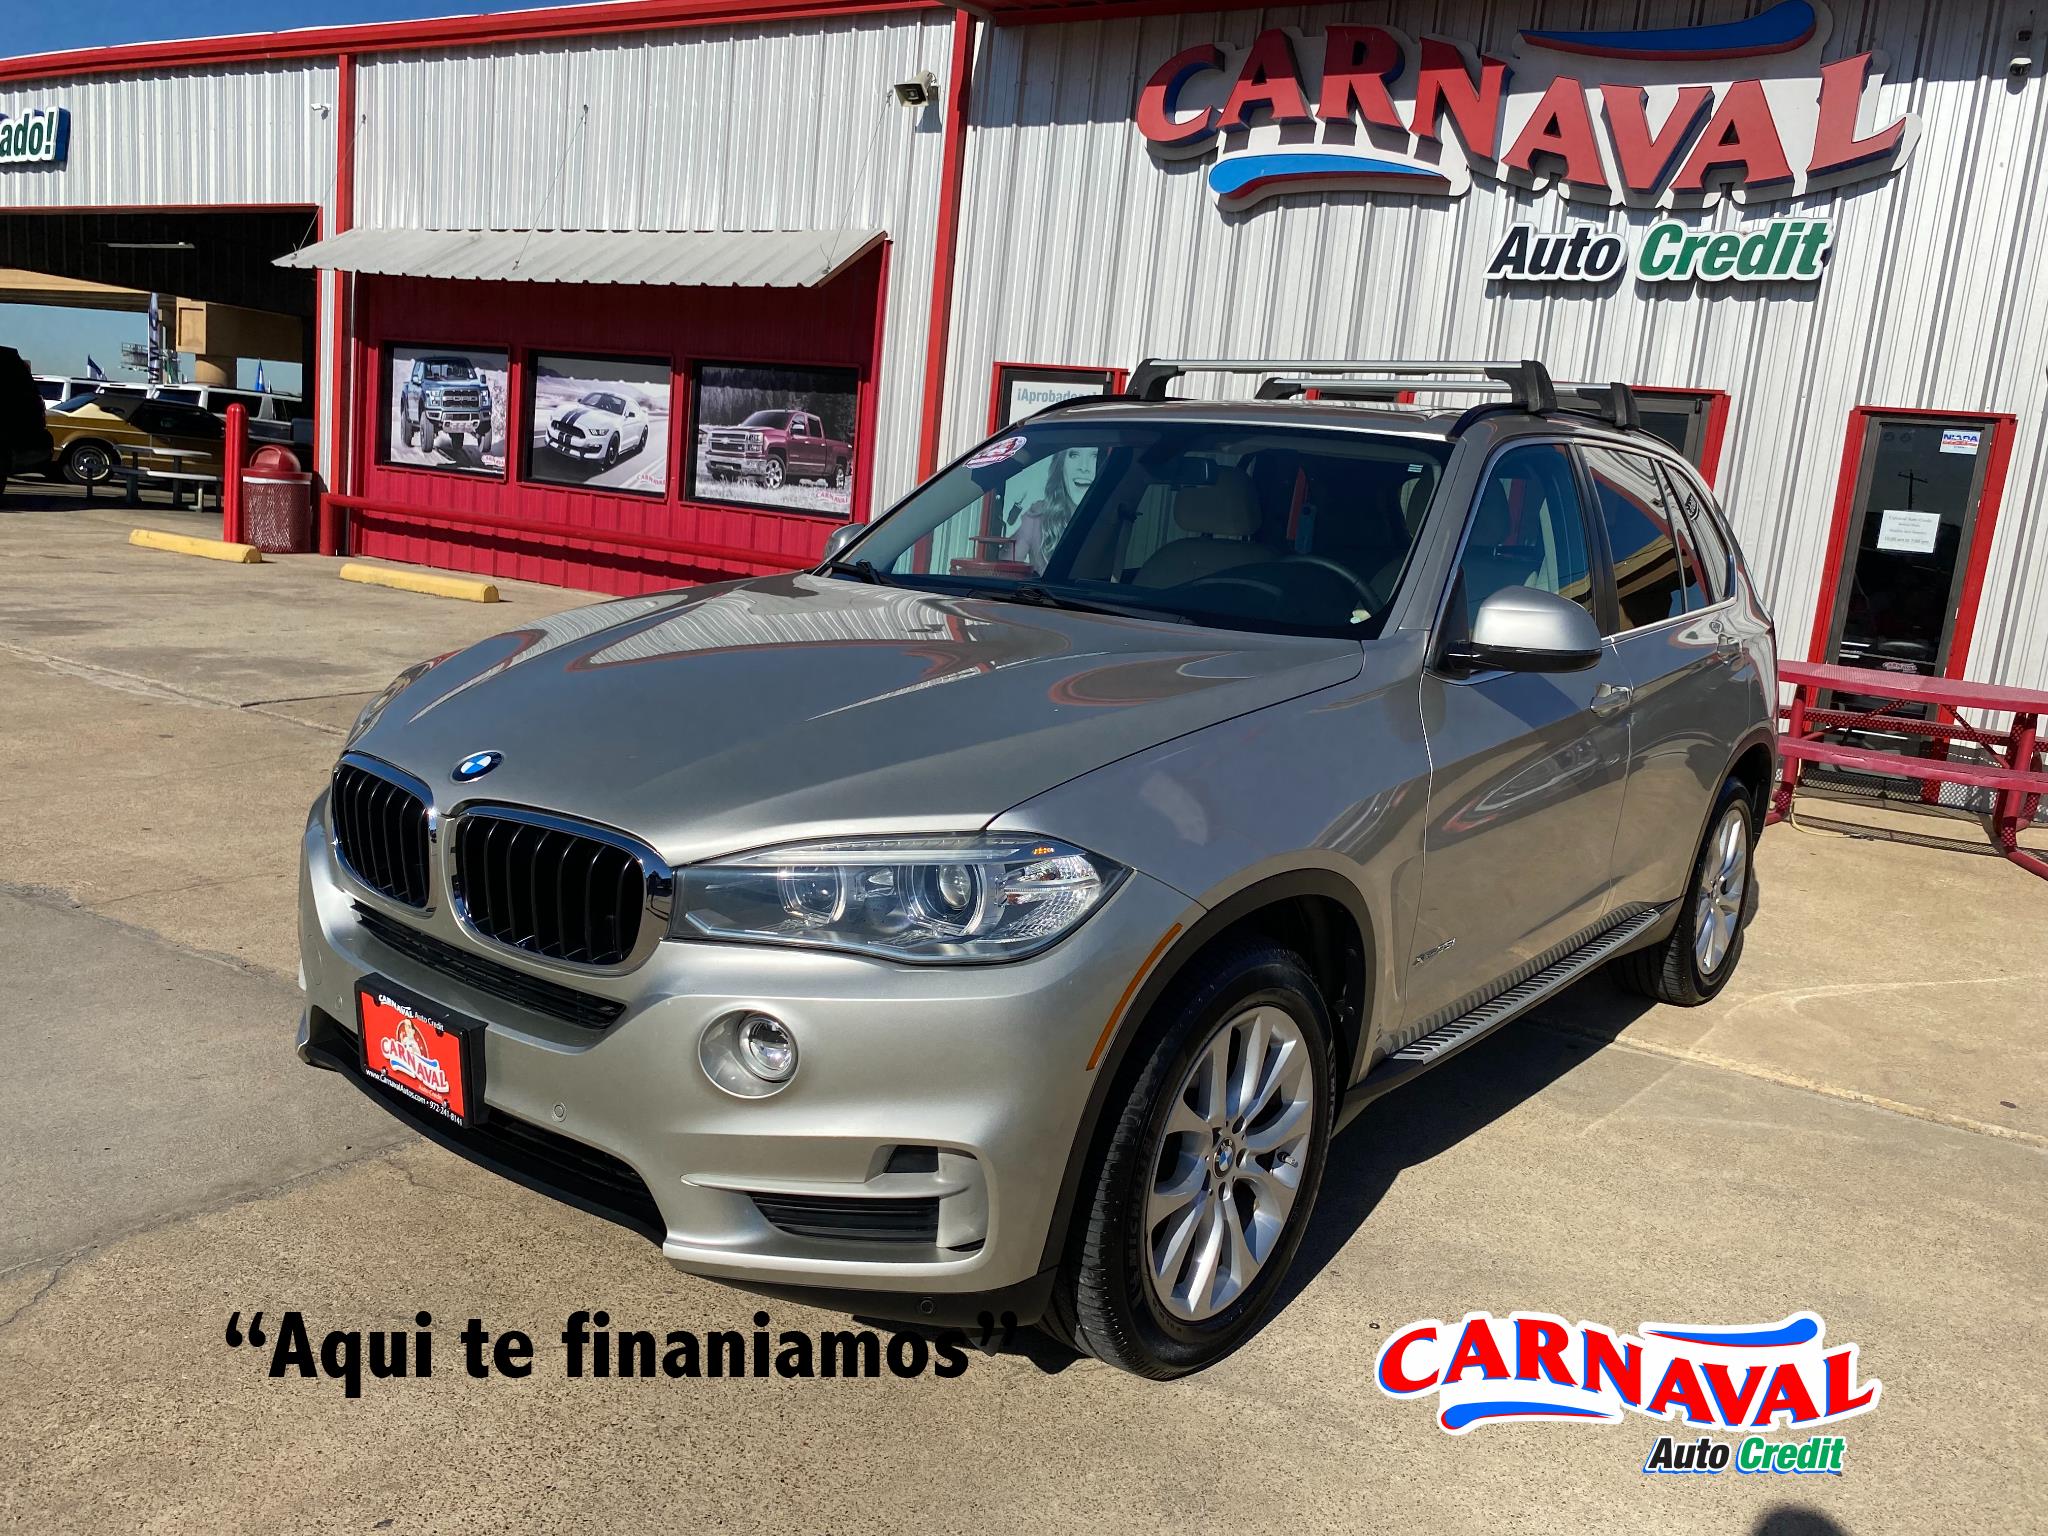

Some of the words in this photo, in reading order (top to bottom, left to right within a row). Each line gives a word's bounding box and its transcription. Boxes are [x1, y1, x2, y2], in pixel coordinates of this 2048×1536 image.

[0, 112, 55, 157] ado!
[1136, 23, 1908, 194] CARNAVAL
[1487, 224, 1622, 278] Auto
[1638, 220, 1830, 276] Credit
[381, 1037, 448, 1090] CARNAVAL
